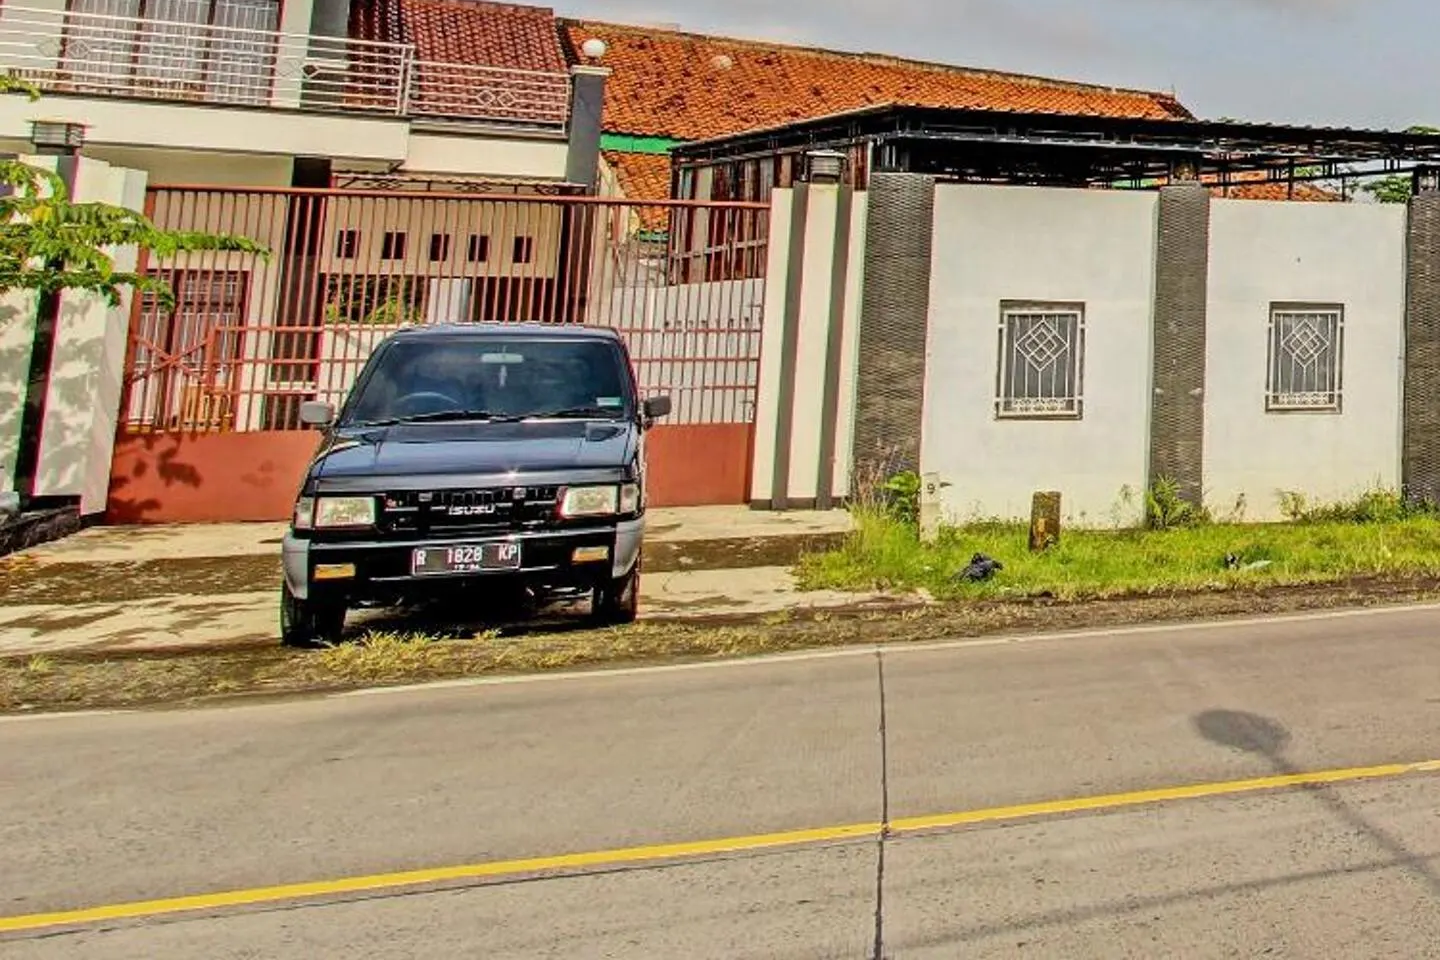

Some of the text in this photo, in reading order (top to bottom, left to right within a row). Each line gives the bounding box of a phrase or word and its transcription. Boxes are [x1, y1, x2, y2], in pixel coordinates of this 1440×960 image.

[448, 504, 496, 515] ISUZU
[416, 545, 518, 565] R 1828 KP
